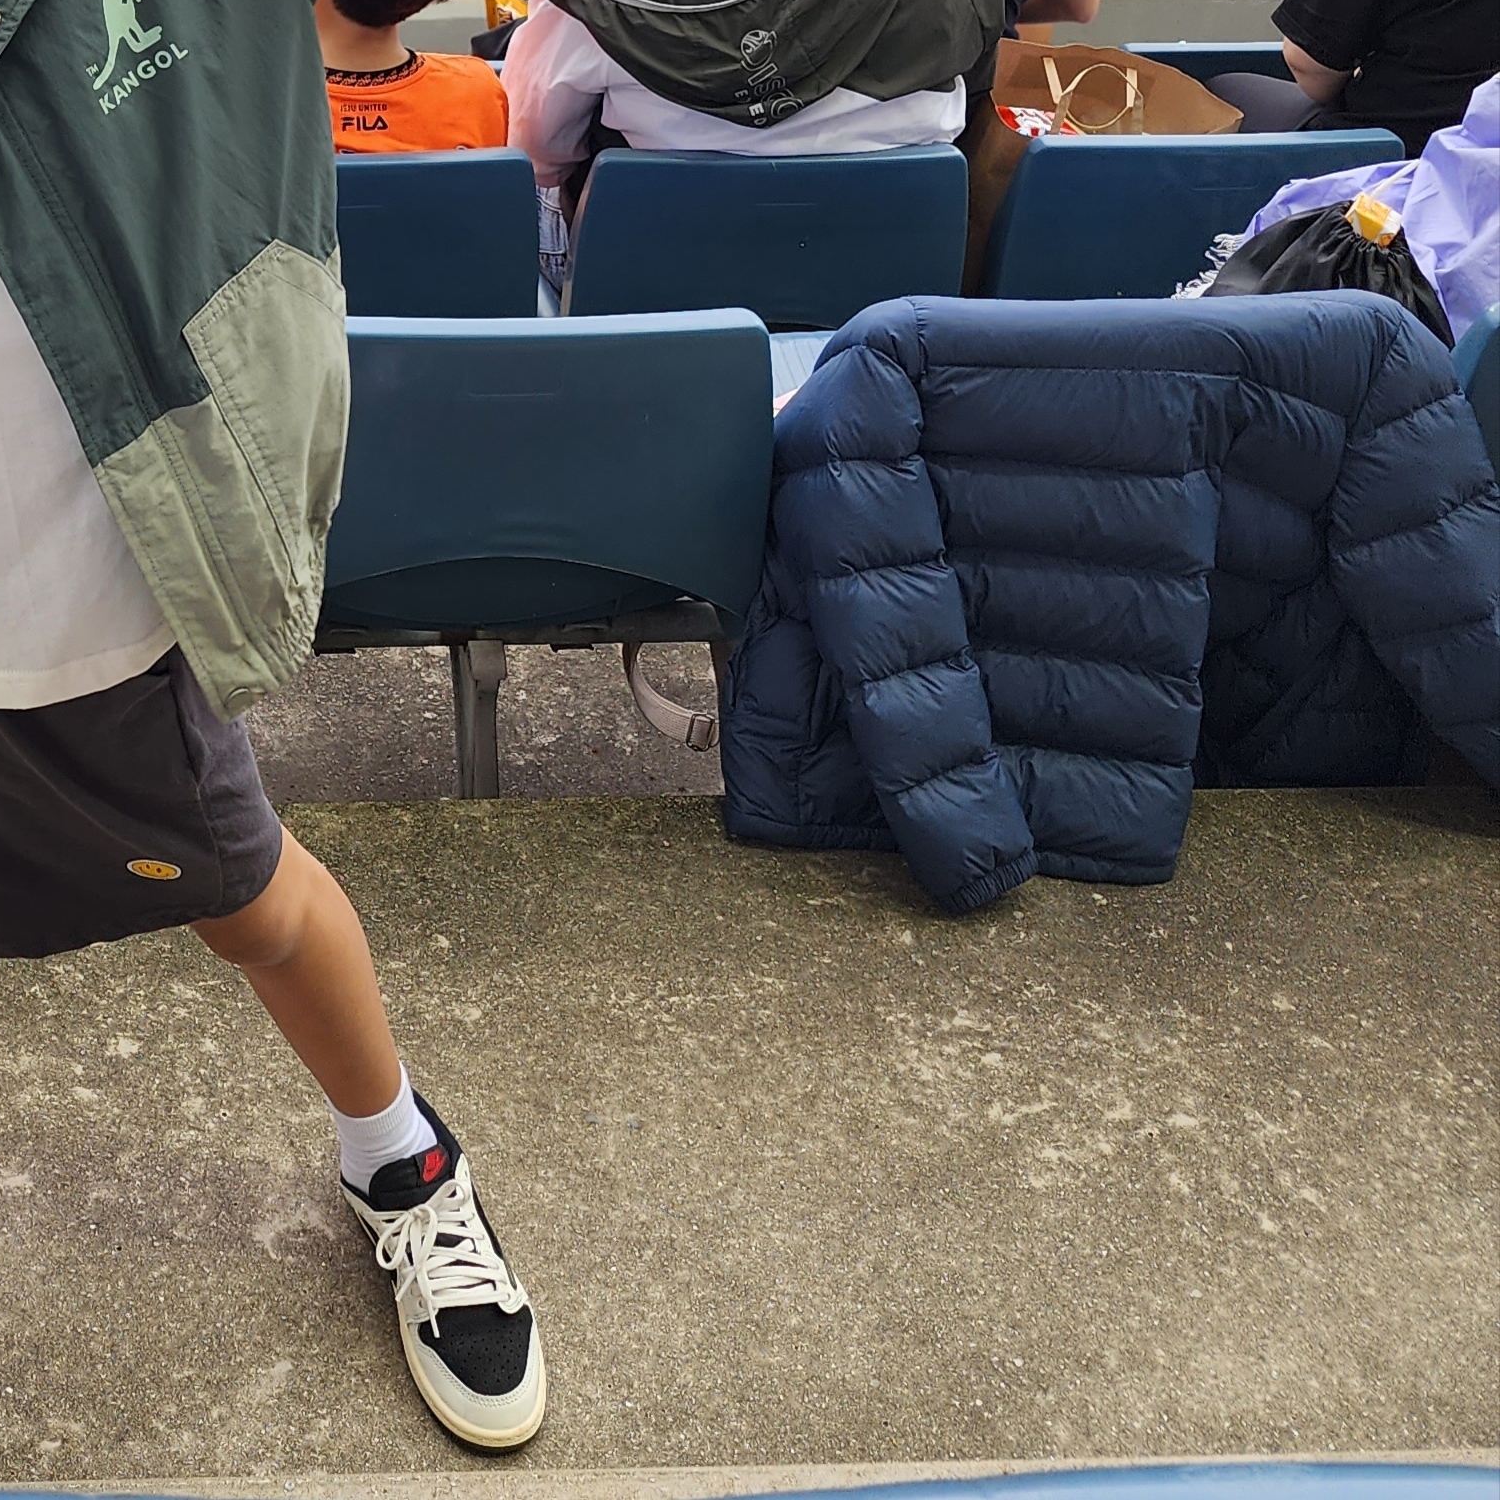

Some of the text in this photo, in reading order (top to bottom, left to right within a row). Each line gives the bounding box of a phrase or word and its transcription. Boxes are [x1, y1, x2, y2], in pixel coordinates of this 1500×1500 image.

[85, 63, 99, 78] TM
[99, 43, 189, 116] KANGOL
[358, 103, 388, 112] UNITED
[340, 114, 389, 132] FILA
